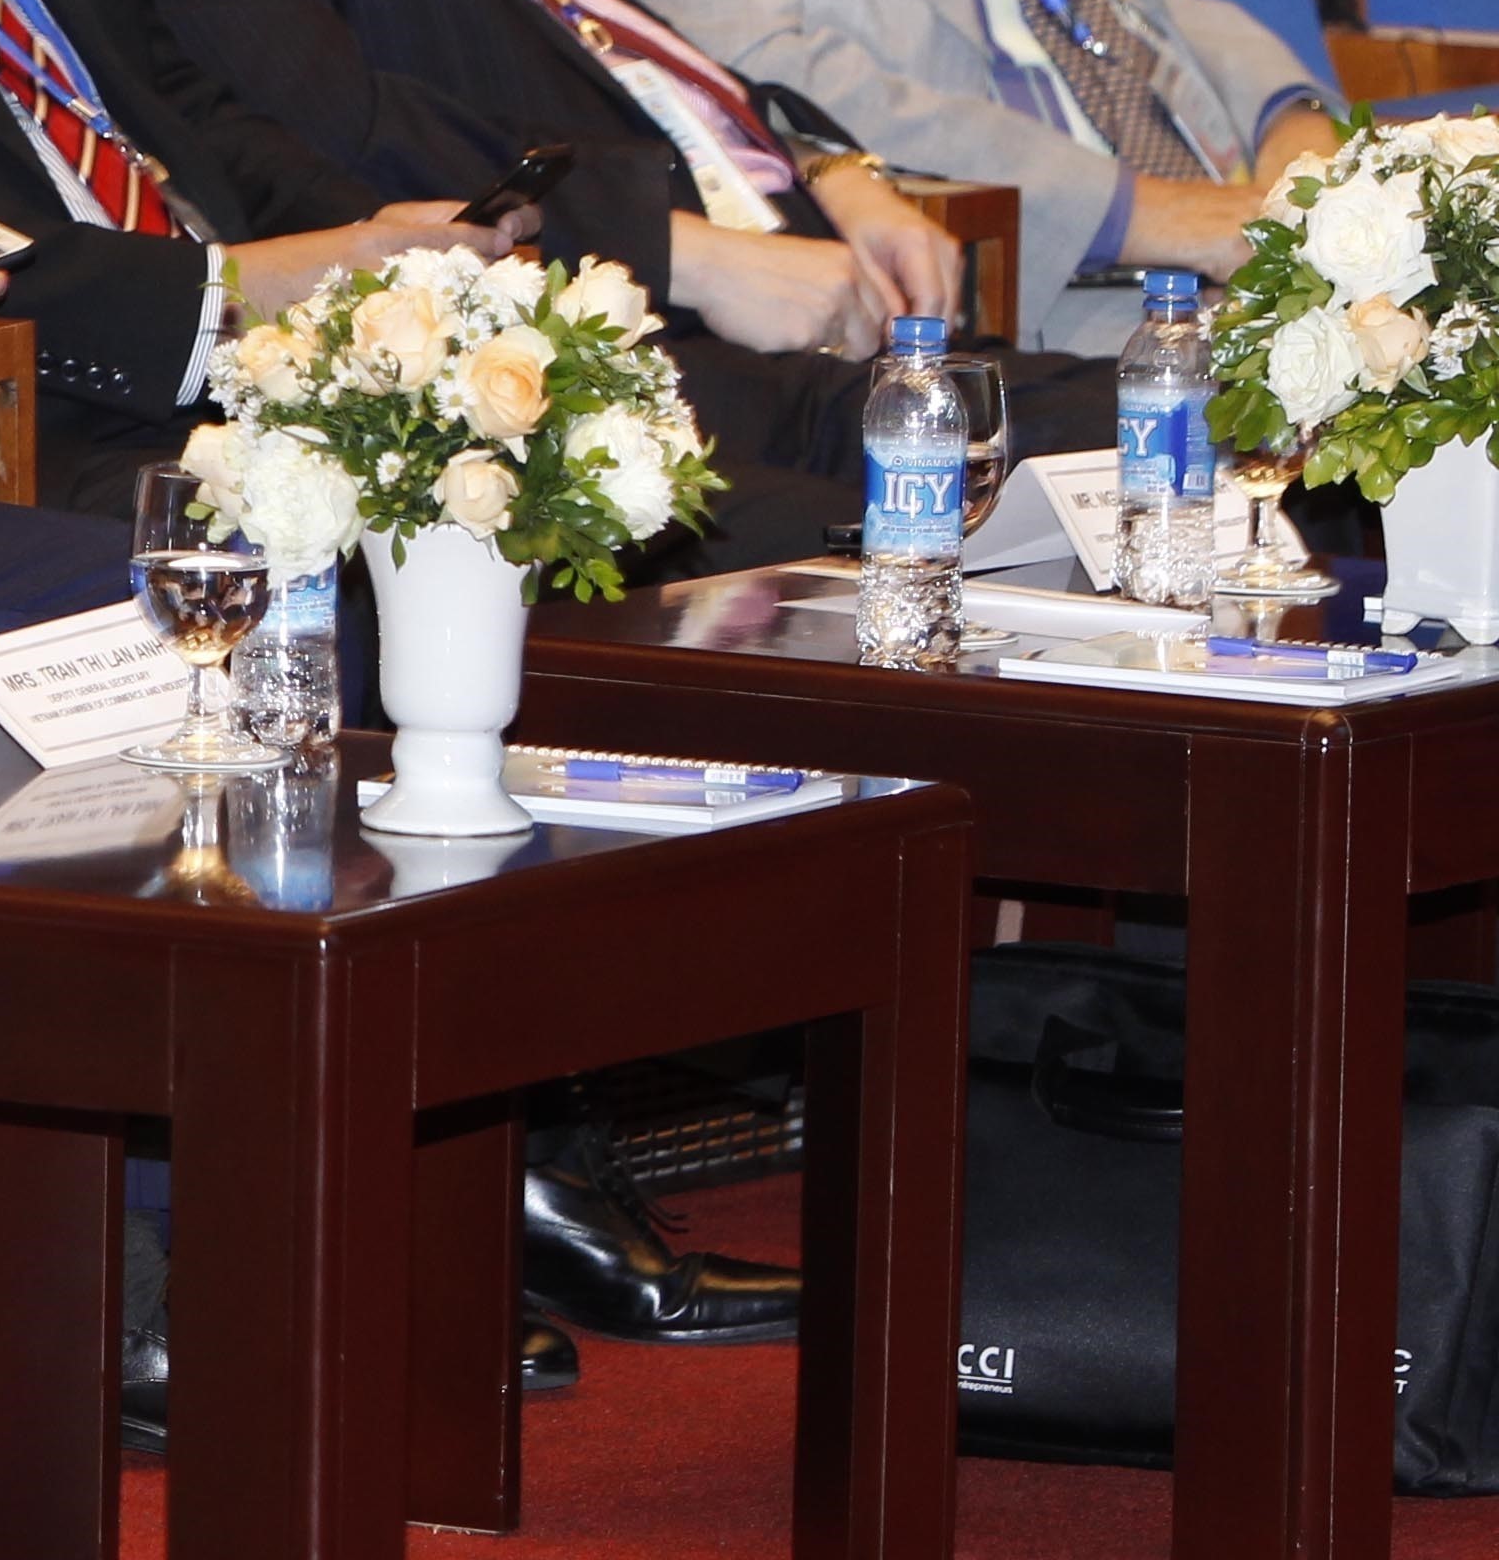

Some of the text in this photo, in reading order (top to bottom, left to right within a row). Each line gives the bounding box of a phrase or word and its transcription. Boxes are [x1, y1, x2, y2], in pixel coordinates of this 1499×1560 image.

[882, 471, 955, 515] ICY
[1, 637, 167, 693] MRS. TRAN THI LAN ANH
